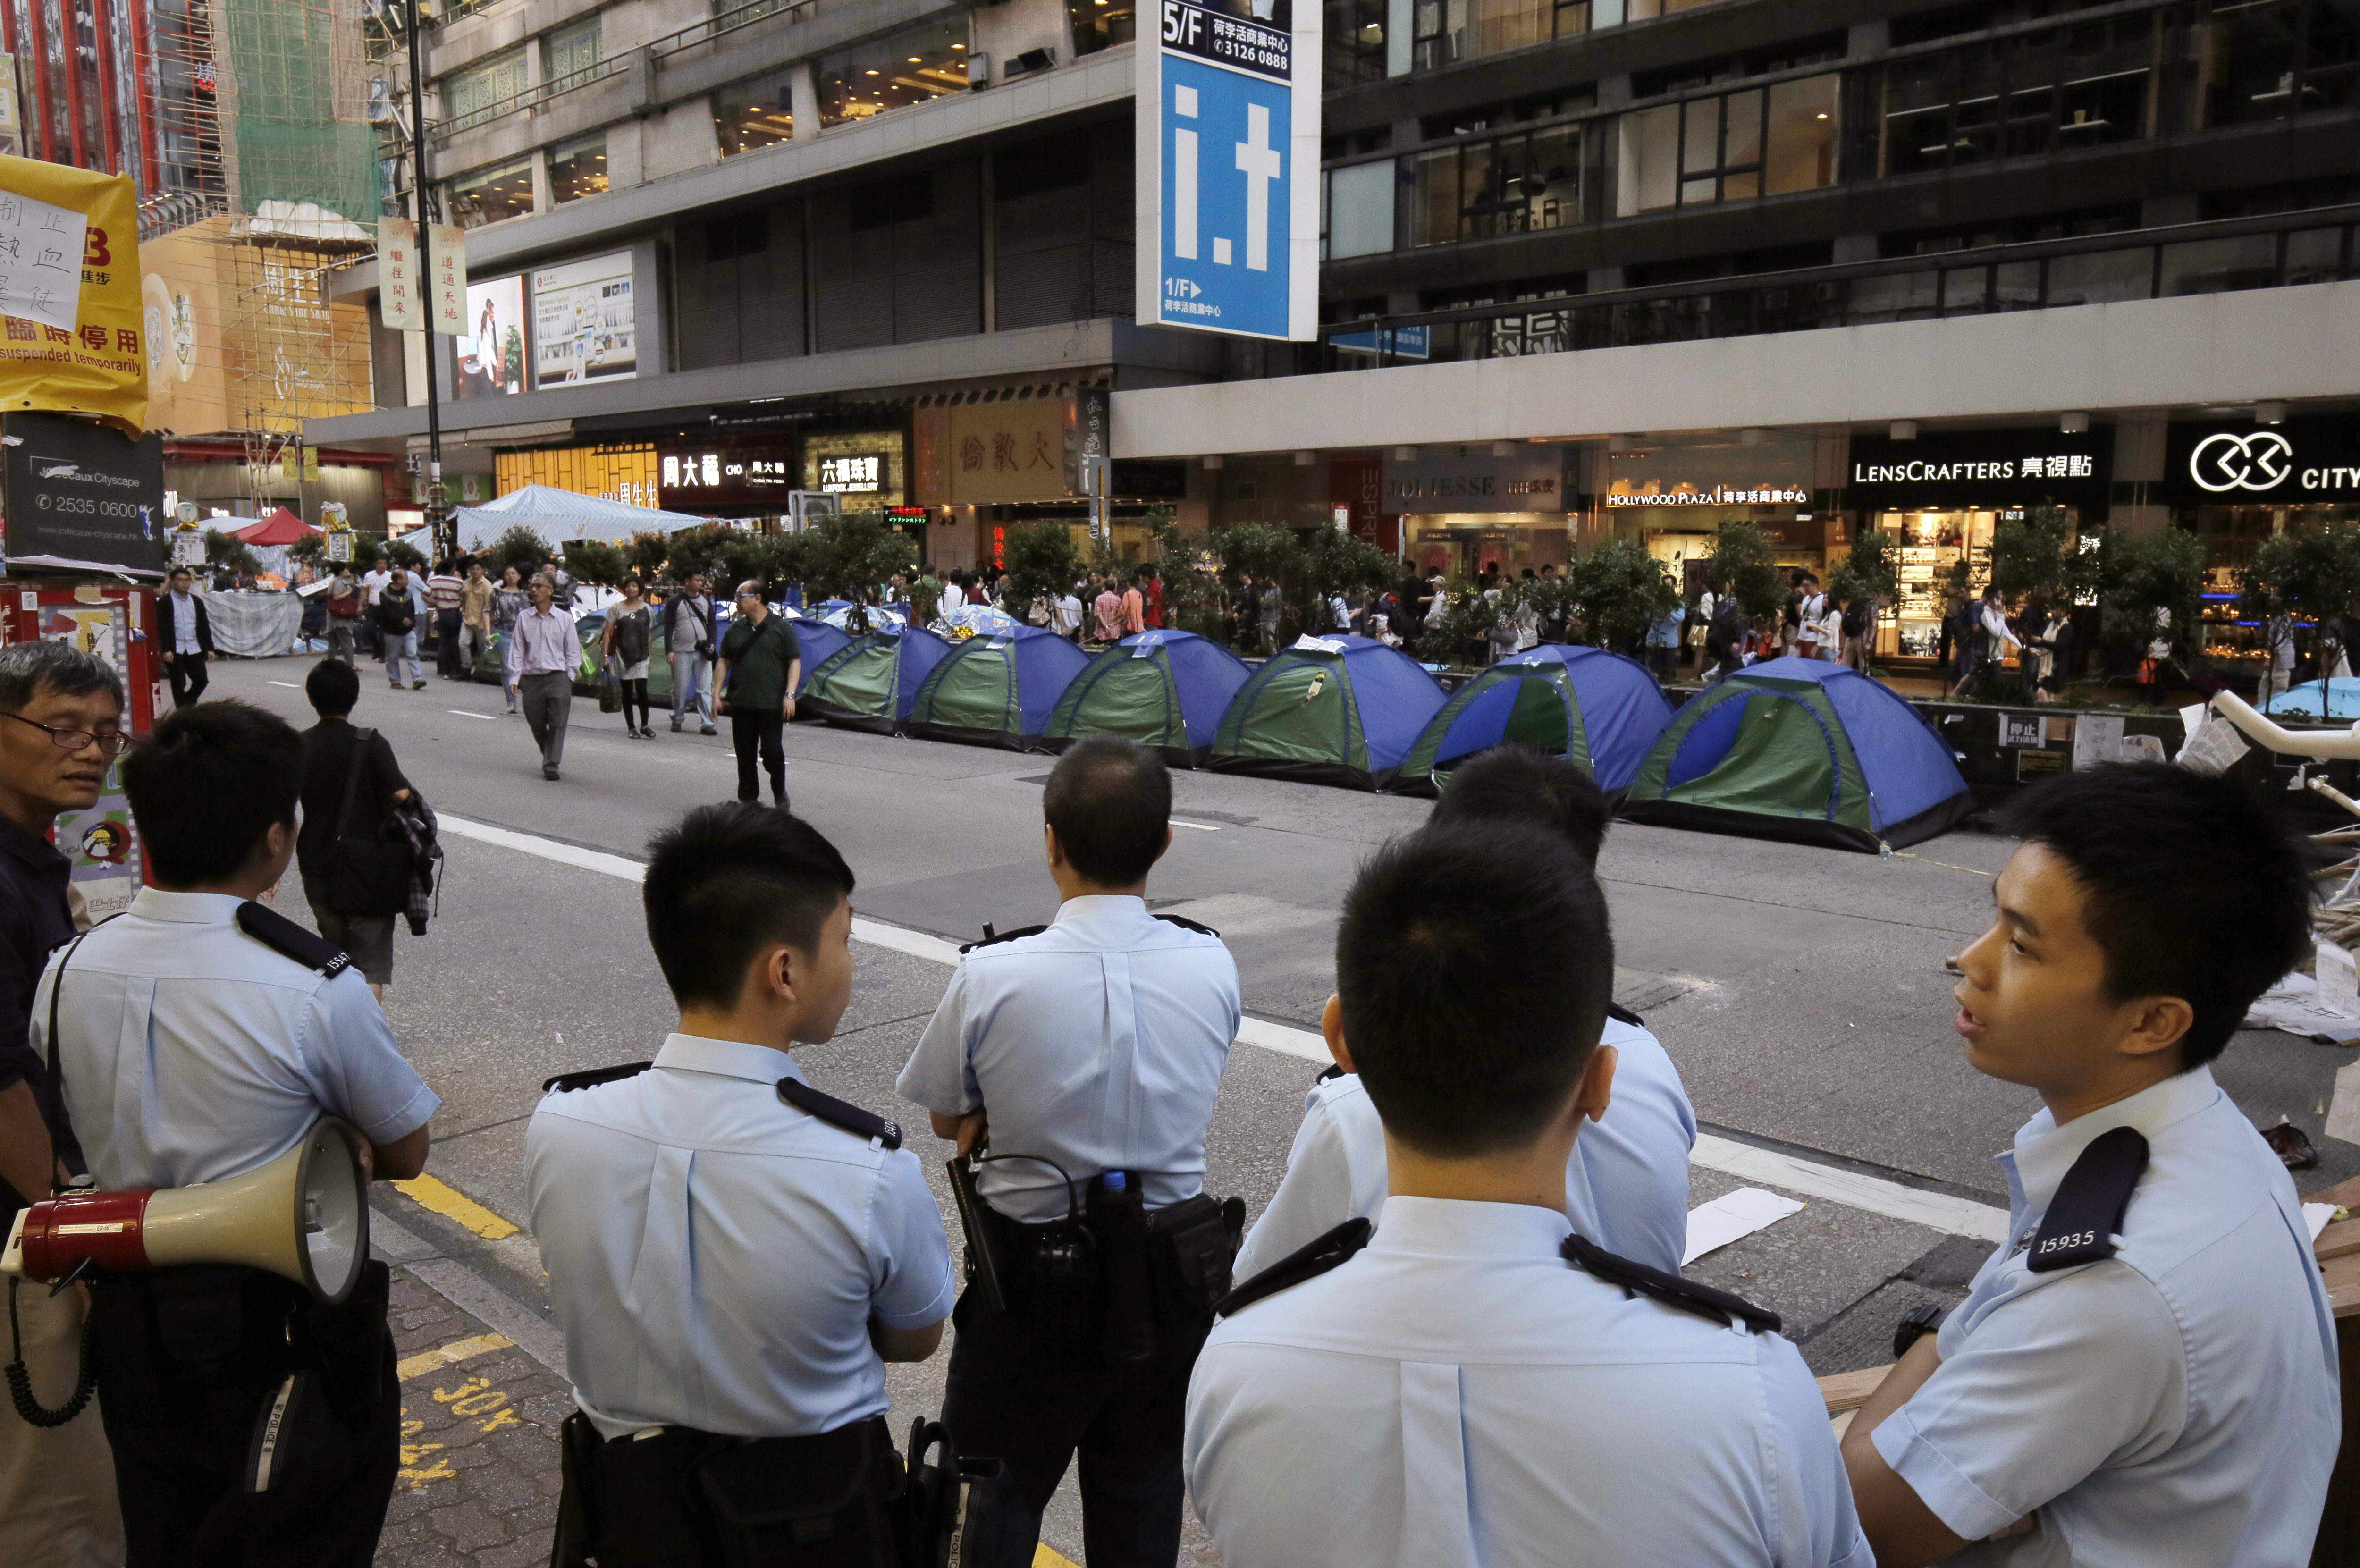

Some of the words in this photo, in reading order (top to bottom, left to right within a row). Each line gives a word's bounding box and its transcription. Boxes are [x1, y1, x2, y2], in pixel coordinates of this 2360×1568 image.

[1163, 1, 1202, 45] 5/F
[1213, 19, 1288, 53] 荷李活商業中心
[1225, 41, 1255, 61] 3126
[1258, 50, 1287, 70] 0888
[390, 250, 406, 314] 繼往開來
[441, 256, 458, 320] 道通天地
[1165, 277, 1189, 297] 1/F
[1164, 299, 1221, 317] 荷李活商業中心
[0, 347, 71, 363] suspended
[74, 351, 141, 376] temporarily
[663, 455, 720, 487] 周大福
[752, 461, 784, 473] 周大福
[822, 456, 878, 483] 六福珠寶
[2021, 455, 2093, 478] 亮視點
[94, 473, 140, 488] Cityscape
[847, 482, 879, 492] JEWELLERY
[1608, 494, 1676, 506] HOLLYWOOD
[1678, 491, 1714, 505] PLAZA
[1723, 489, 1807, 503] 荷李活商業中心
[56, 497, 95, 514] 2535
[100, 501, 137, 518] 0600
[37, 526, 138, 540] www.jcdecaux-cityscape.hk
[89, 895, 130, 912] 巴士仔
[327, 952, 351, 970] 15547
[2038, 1230, 2095, 1254] 15935
[265, 1413, 281, 1445] POLICE
